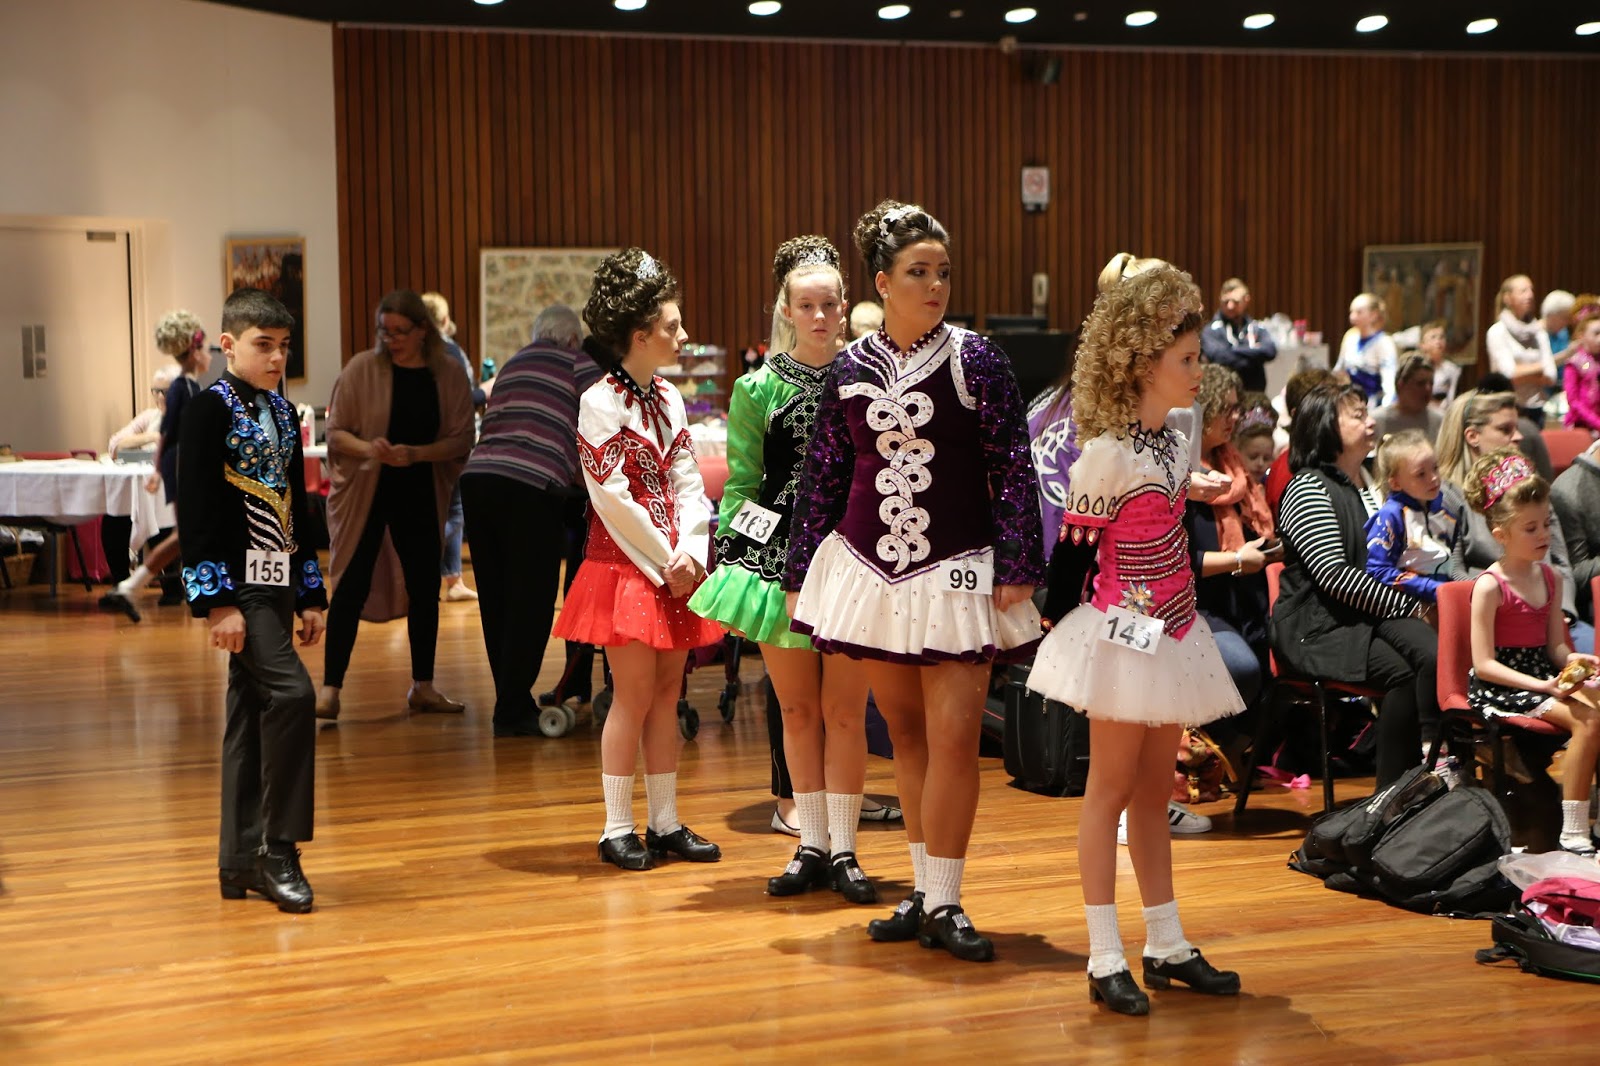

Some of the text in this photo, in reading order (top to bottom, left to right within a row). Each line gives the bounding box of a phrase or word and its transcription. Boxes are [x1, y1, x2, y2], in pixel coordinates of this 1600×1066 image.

[739, 510, 772, 538] 163
[249, 559, 284, 583] 155
[949, 568, 978, 591] 99
